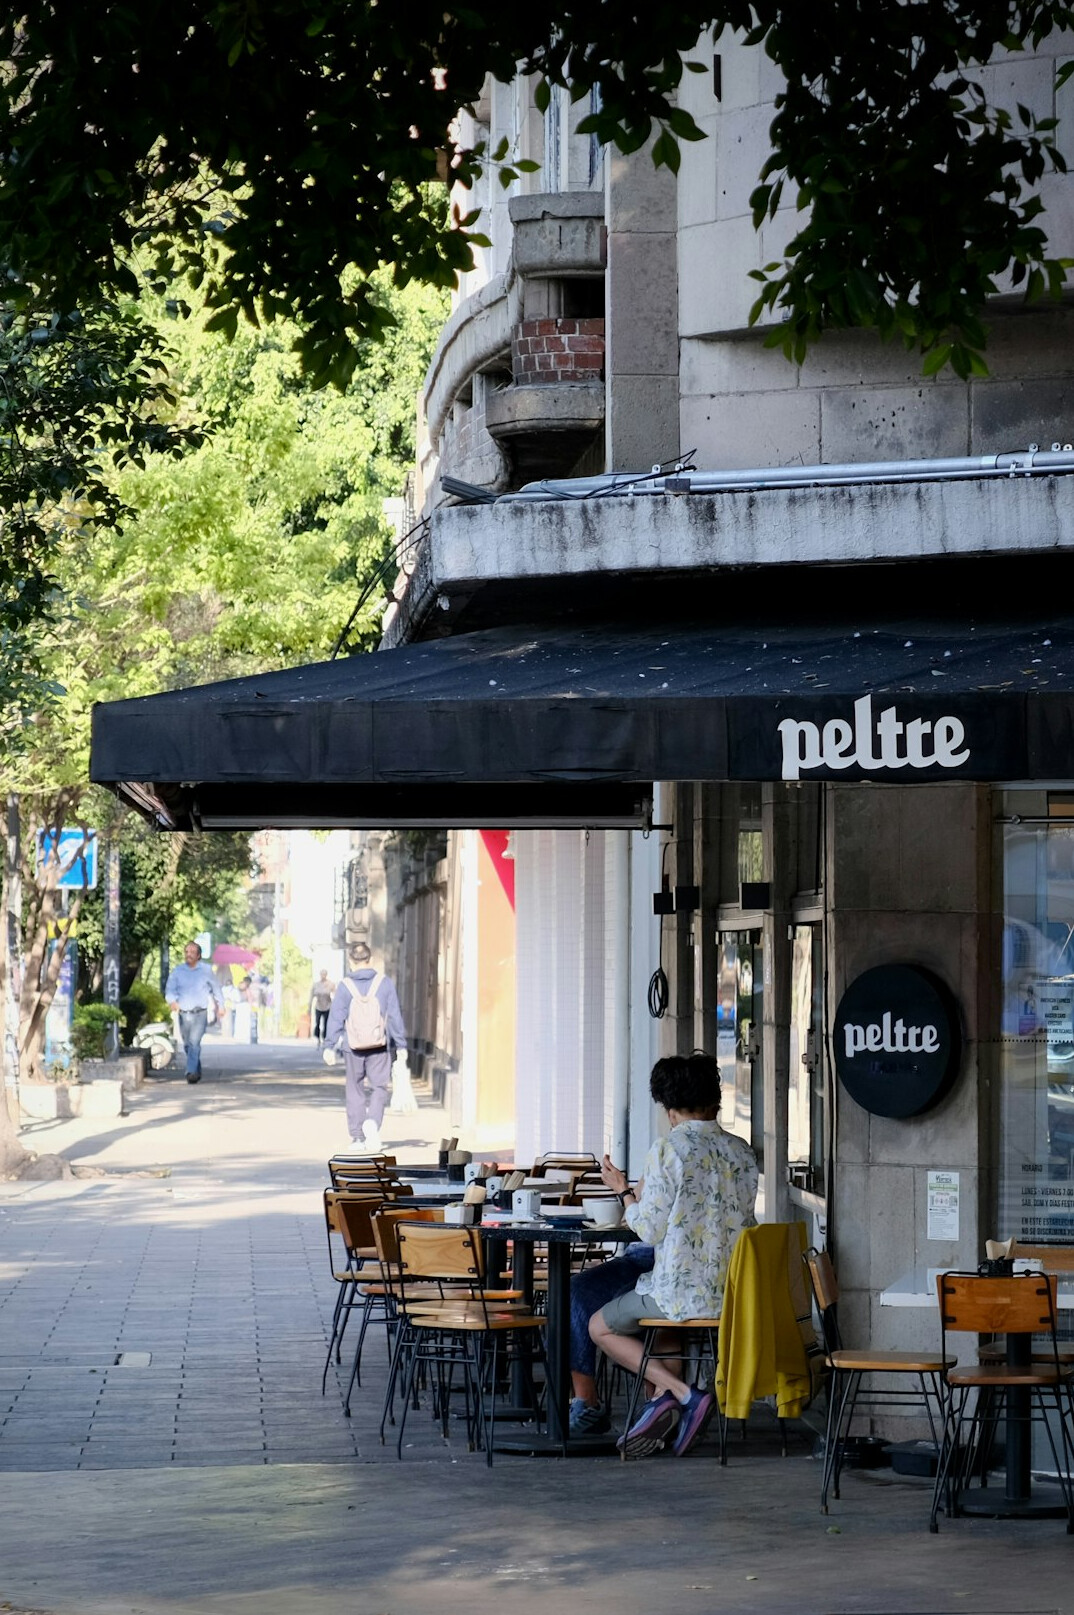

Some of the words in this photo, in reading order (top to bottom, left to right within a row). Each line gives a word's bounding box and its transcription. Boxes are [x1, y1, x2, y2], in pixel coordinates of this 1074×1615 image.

[777, 693, 971, 780] peltre
[843, 1011, 940, 1058] peltre
[1030, 1218, 1042, 1226] ESTE
